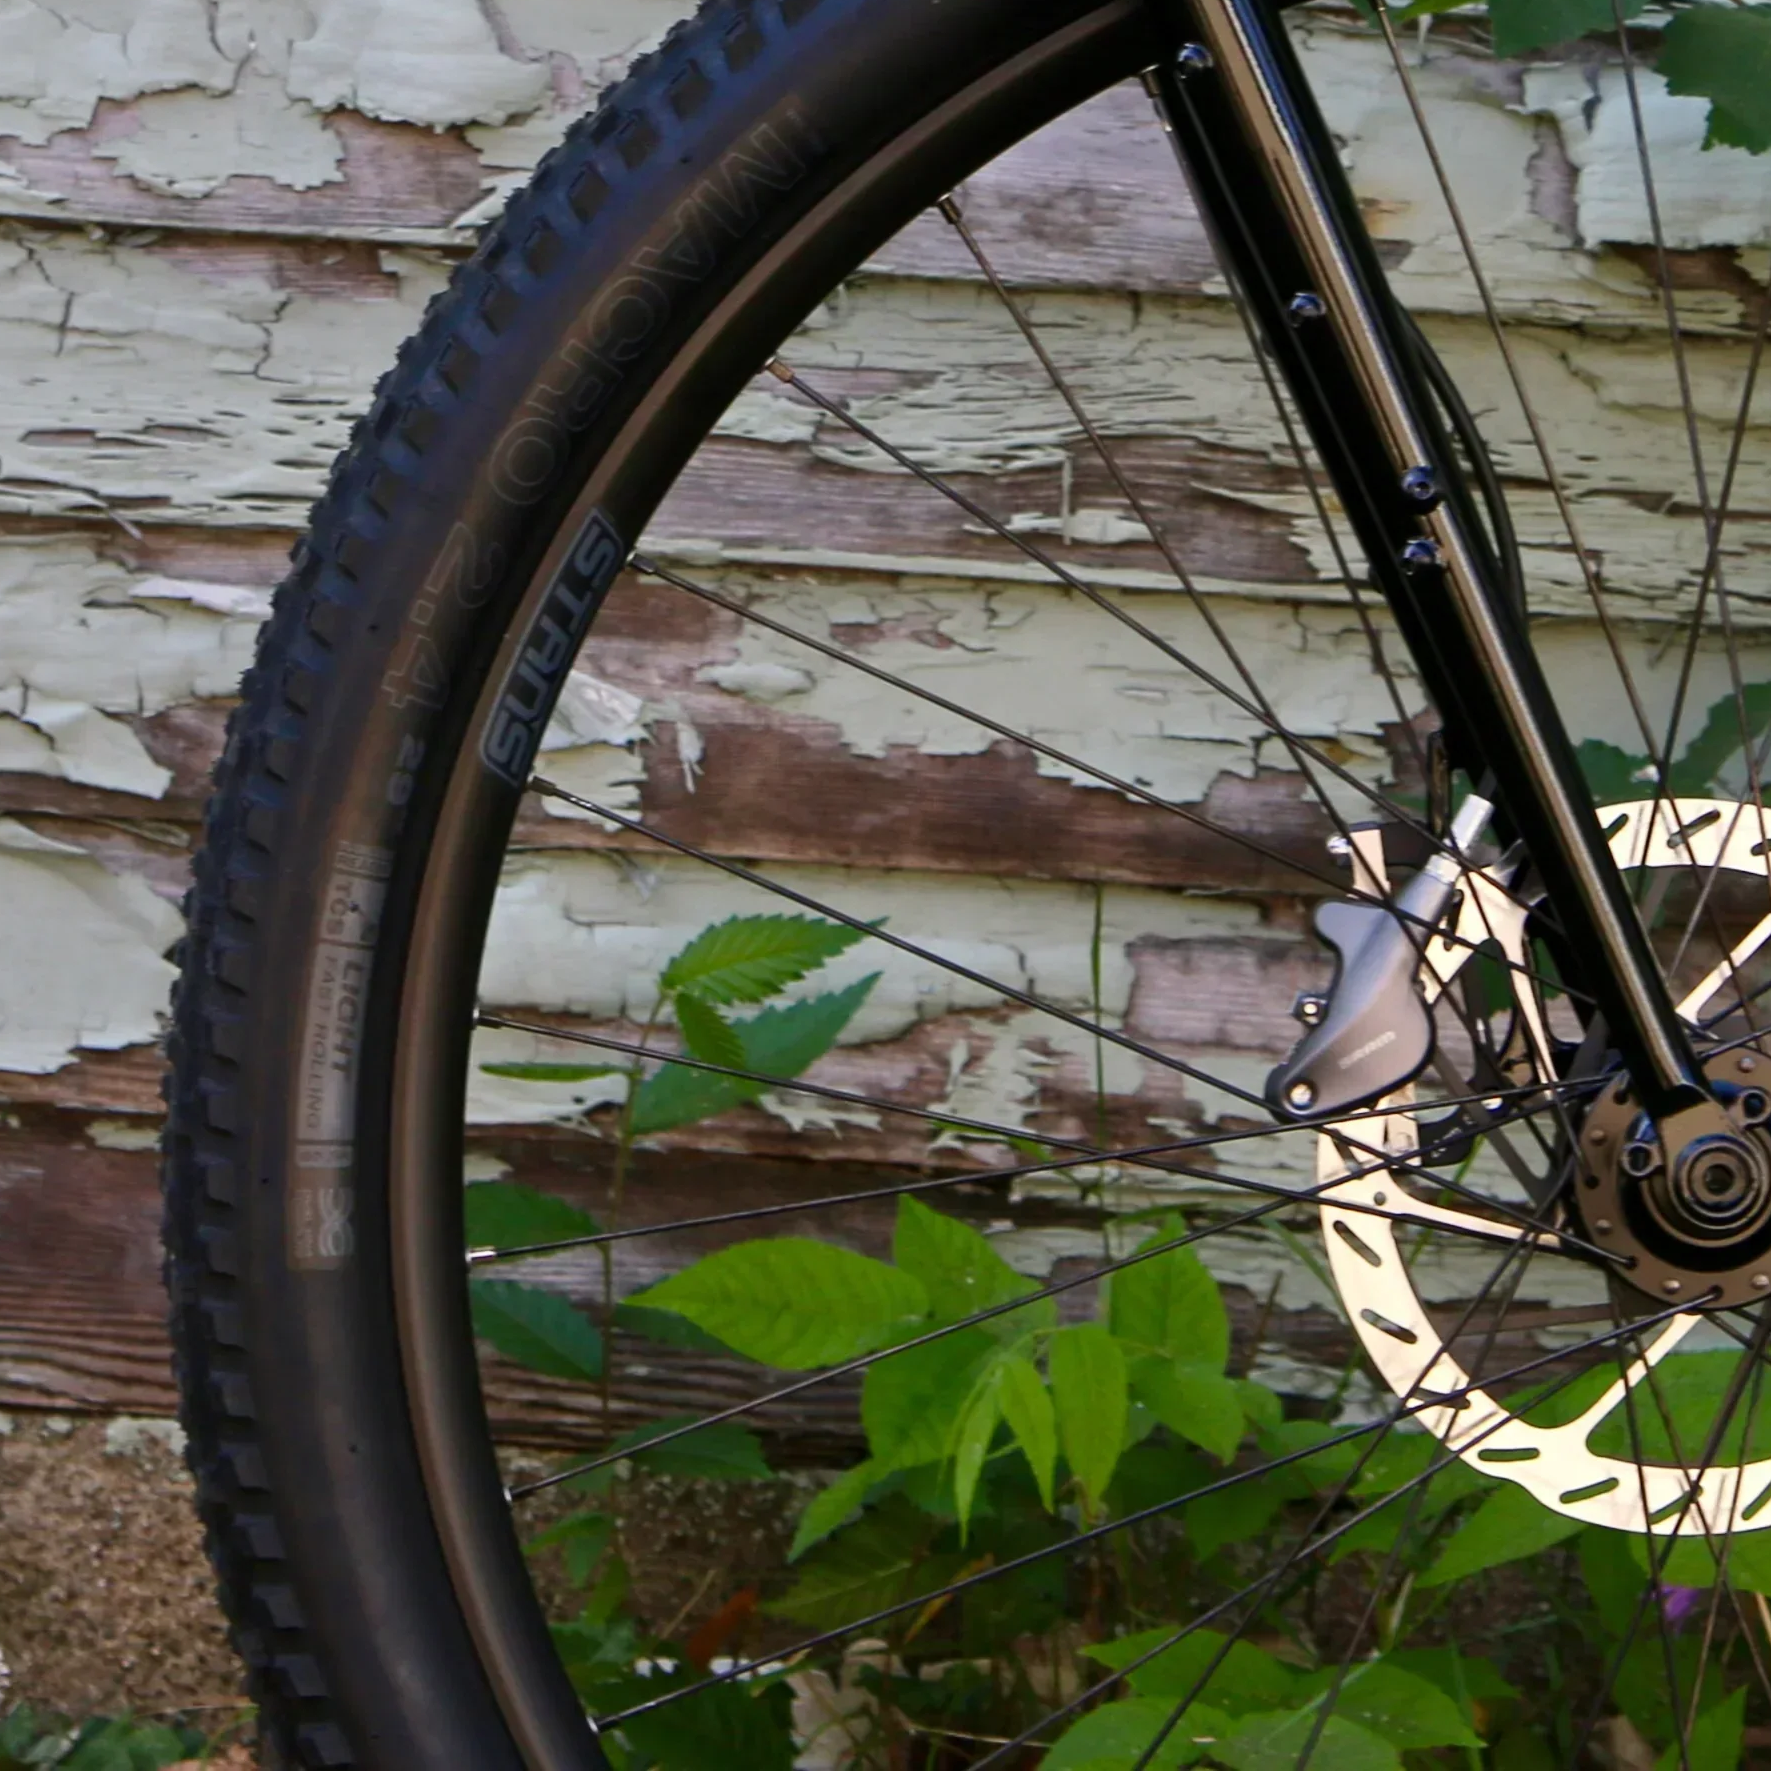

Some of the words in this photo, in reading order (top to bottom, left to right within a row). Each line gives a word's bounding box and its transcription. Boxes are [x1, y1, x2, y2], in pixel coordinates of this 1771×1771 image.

[490, 122, 808, 506] MACRO
[381, 523, 501, 712] 2.4
[486, 522, 618, 780] STANS
[305, 1021, 330, 1130] ROLLING
[333, 960, 366, 1076] LIGHT
